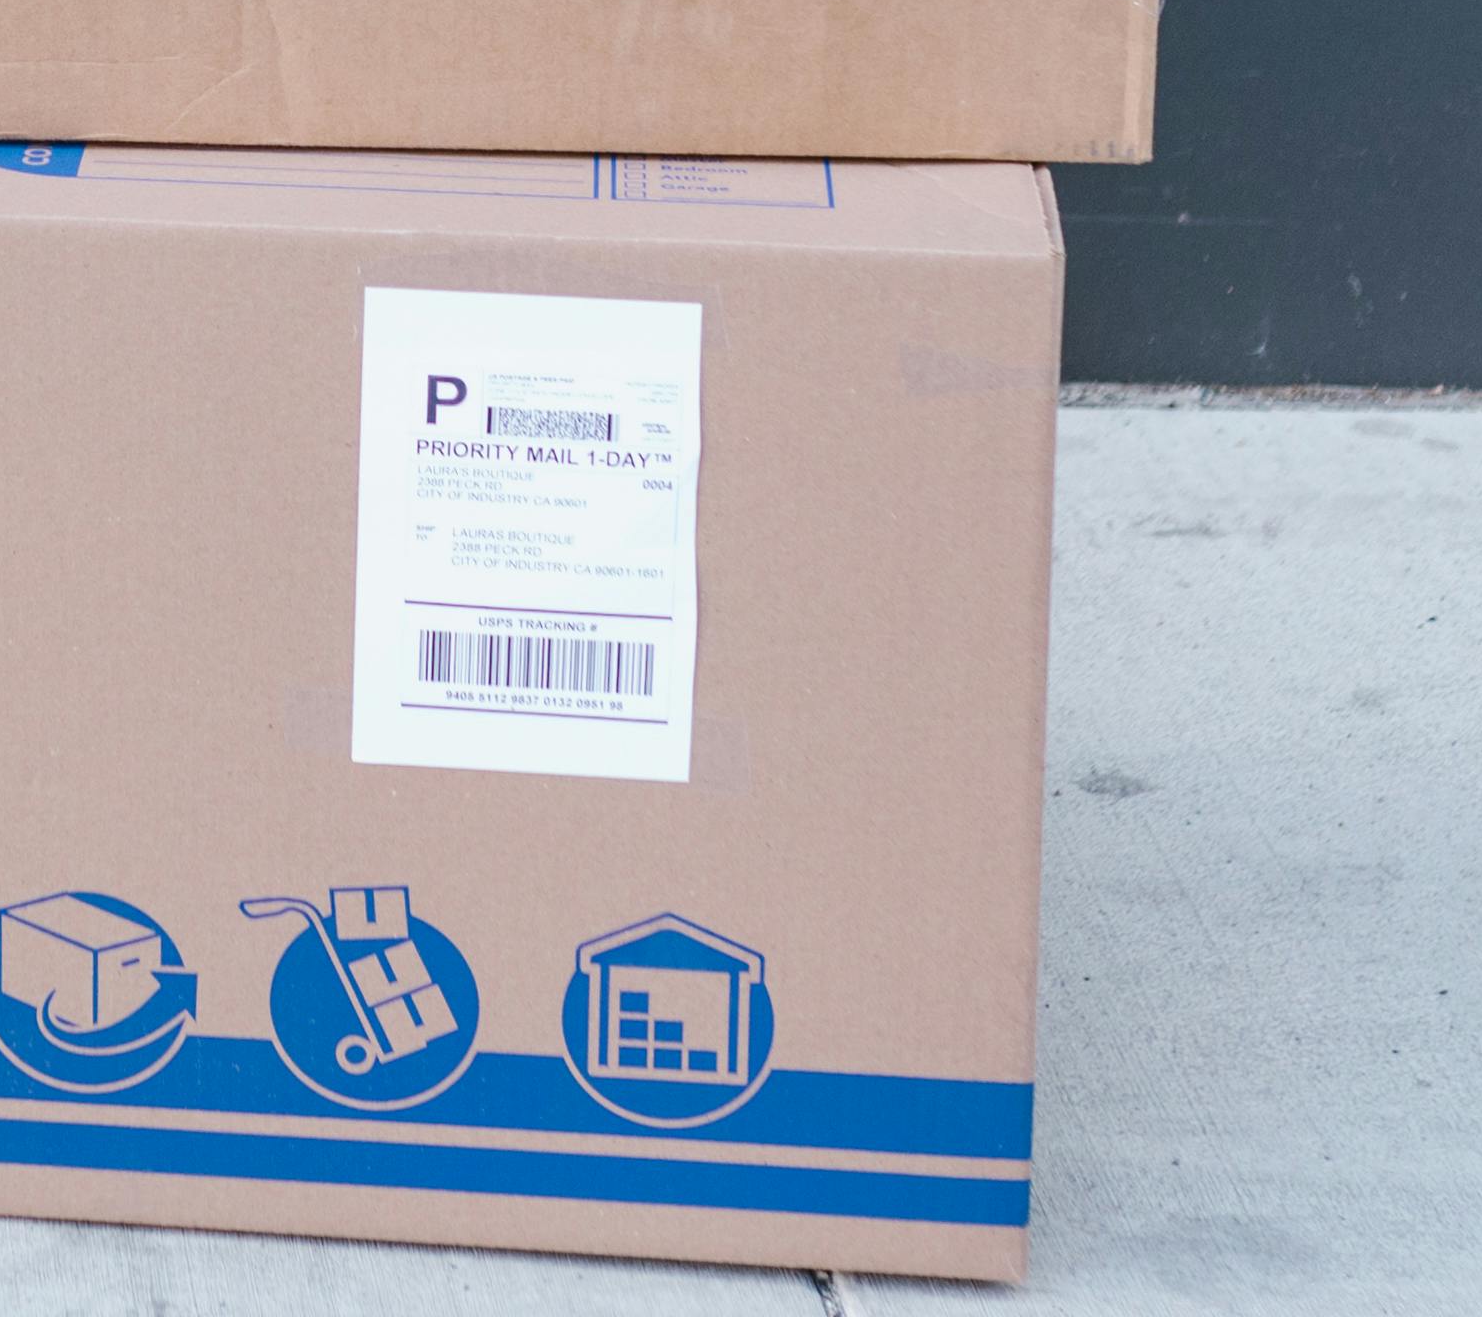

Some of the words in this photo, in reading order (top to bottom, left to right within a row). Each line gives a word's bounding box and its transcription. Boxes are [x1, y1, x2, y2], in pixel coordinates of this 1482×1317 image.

[661, 164, 748, 174] Bedroom
[661, 183, 730, 192] Garage
[426, 374, 468, 425] P
[416, 439, 519, 462] PRIORITY
[526, 446, 579, 466] MAIL
[472, 467, 534, 481] BOUTIQUE
[447, 479, 483, 489] PECK
[485, 481, 503, 490] RD
[643, 479, 673, 491] 0004
[417, 489, 444, 499] CITY
[448, 490, 464, 500] OF
[467, 492, 529, 505] INDUSTRY
[533, 496, 551, 506] CA
[508, 530, 574, 545] BOUTIQUE
[484, 544, 520, 555] PECK
[524, 546, 542, 555] RD
[451, 556, 480, 567] CITY
[484, 557, 501, 568] OF
[505, 559, 569, 573] INDUSTRY
[574, 564, 592, 574] CA
[478, 616, 513, 628] USPS
[519, 618, 586, 632] TRACKING
[590, 623, 598, 631] #
